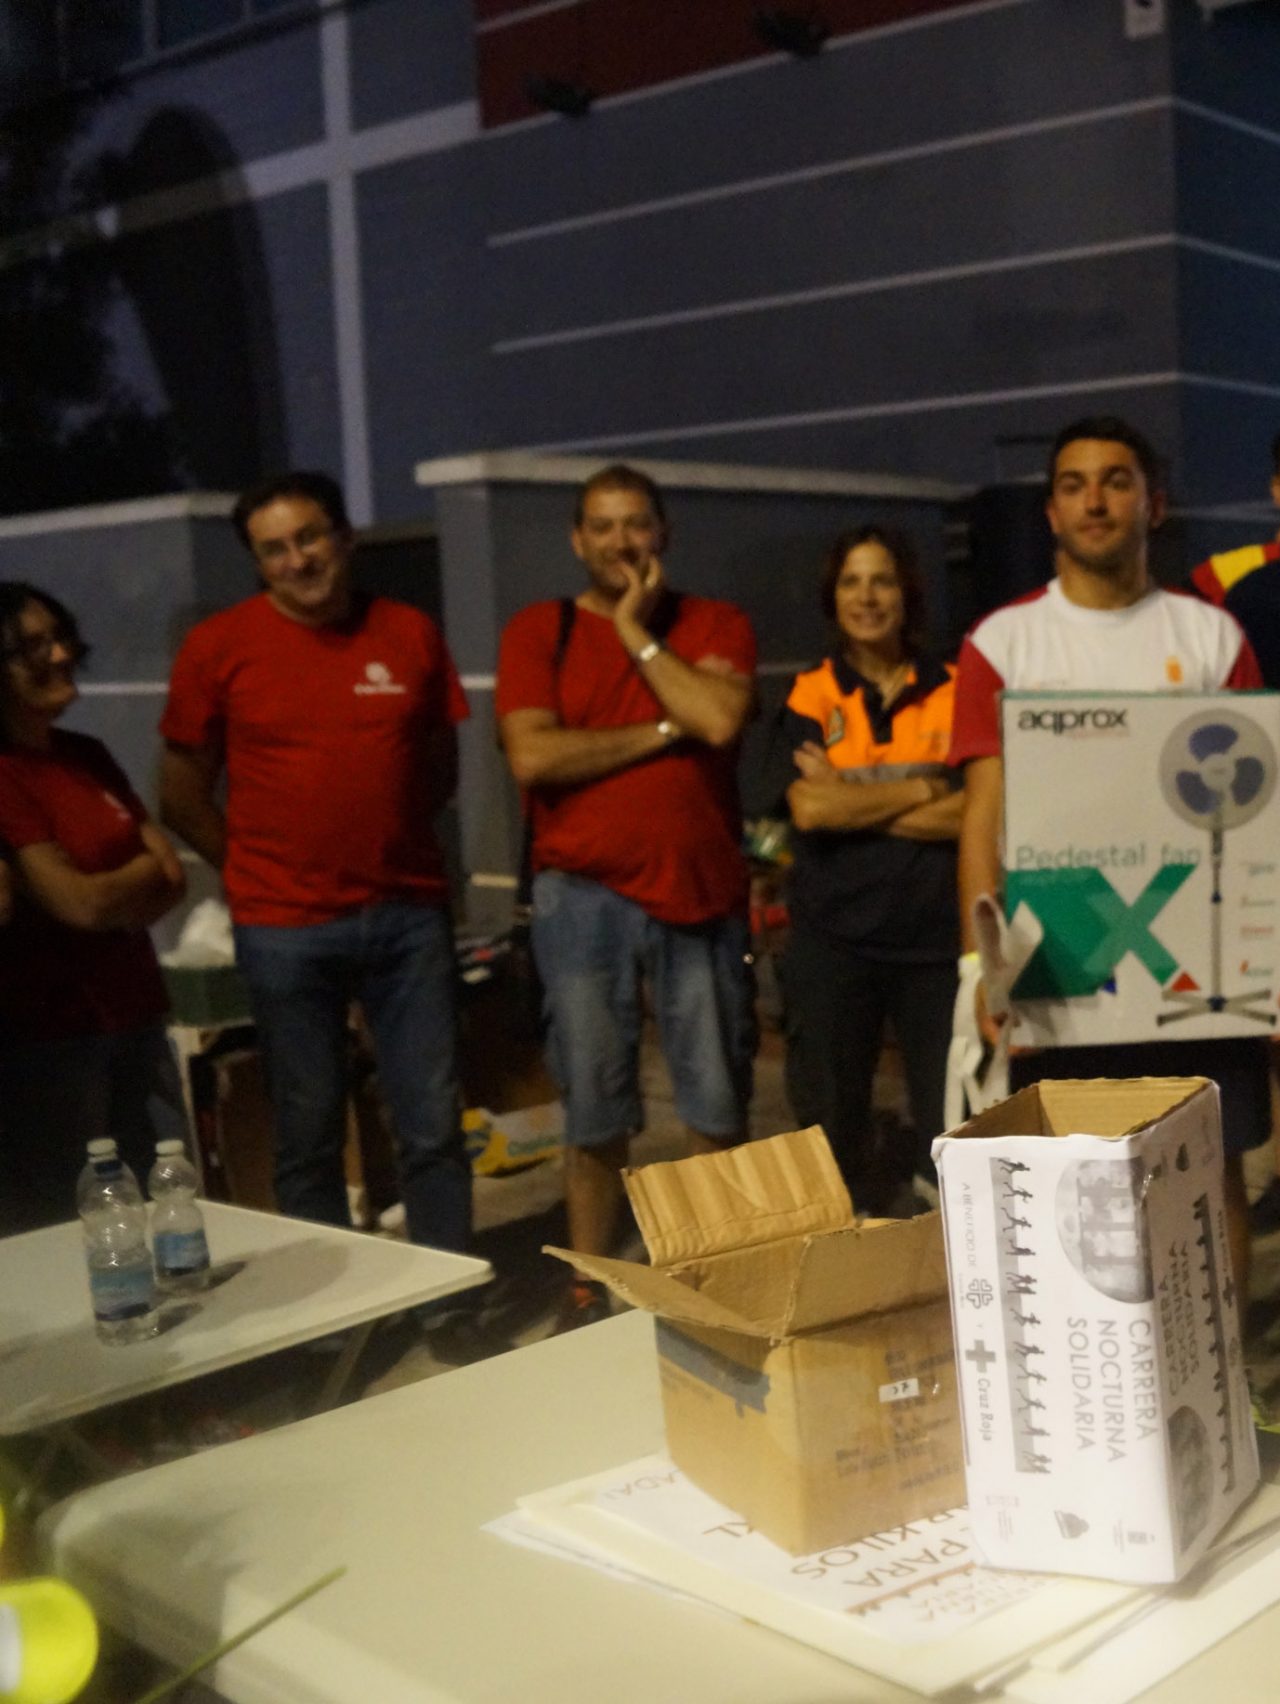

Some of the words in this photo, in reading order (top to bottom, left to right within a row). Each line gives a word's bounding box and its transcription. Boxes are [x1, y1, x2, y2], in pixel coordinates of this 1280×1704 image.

[1067, 1316, 1096, 1450] SOLIDARIA
[1097, 1319, 1127, 1462] NOCTURNA
[1128, 1319, 1159, 1441] CARRERA
[844, 1538, 968, 1589] PARA
